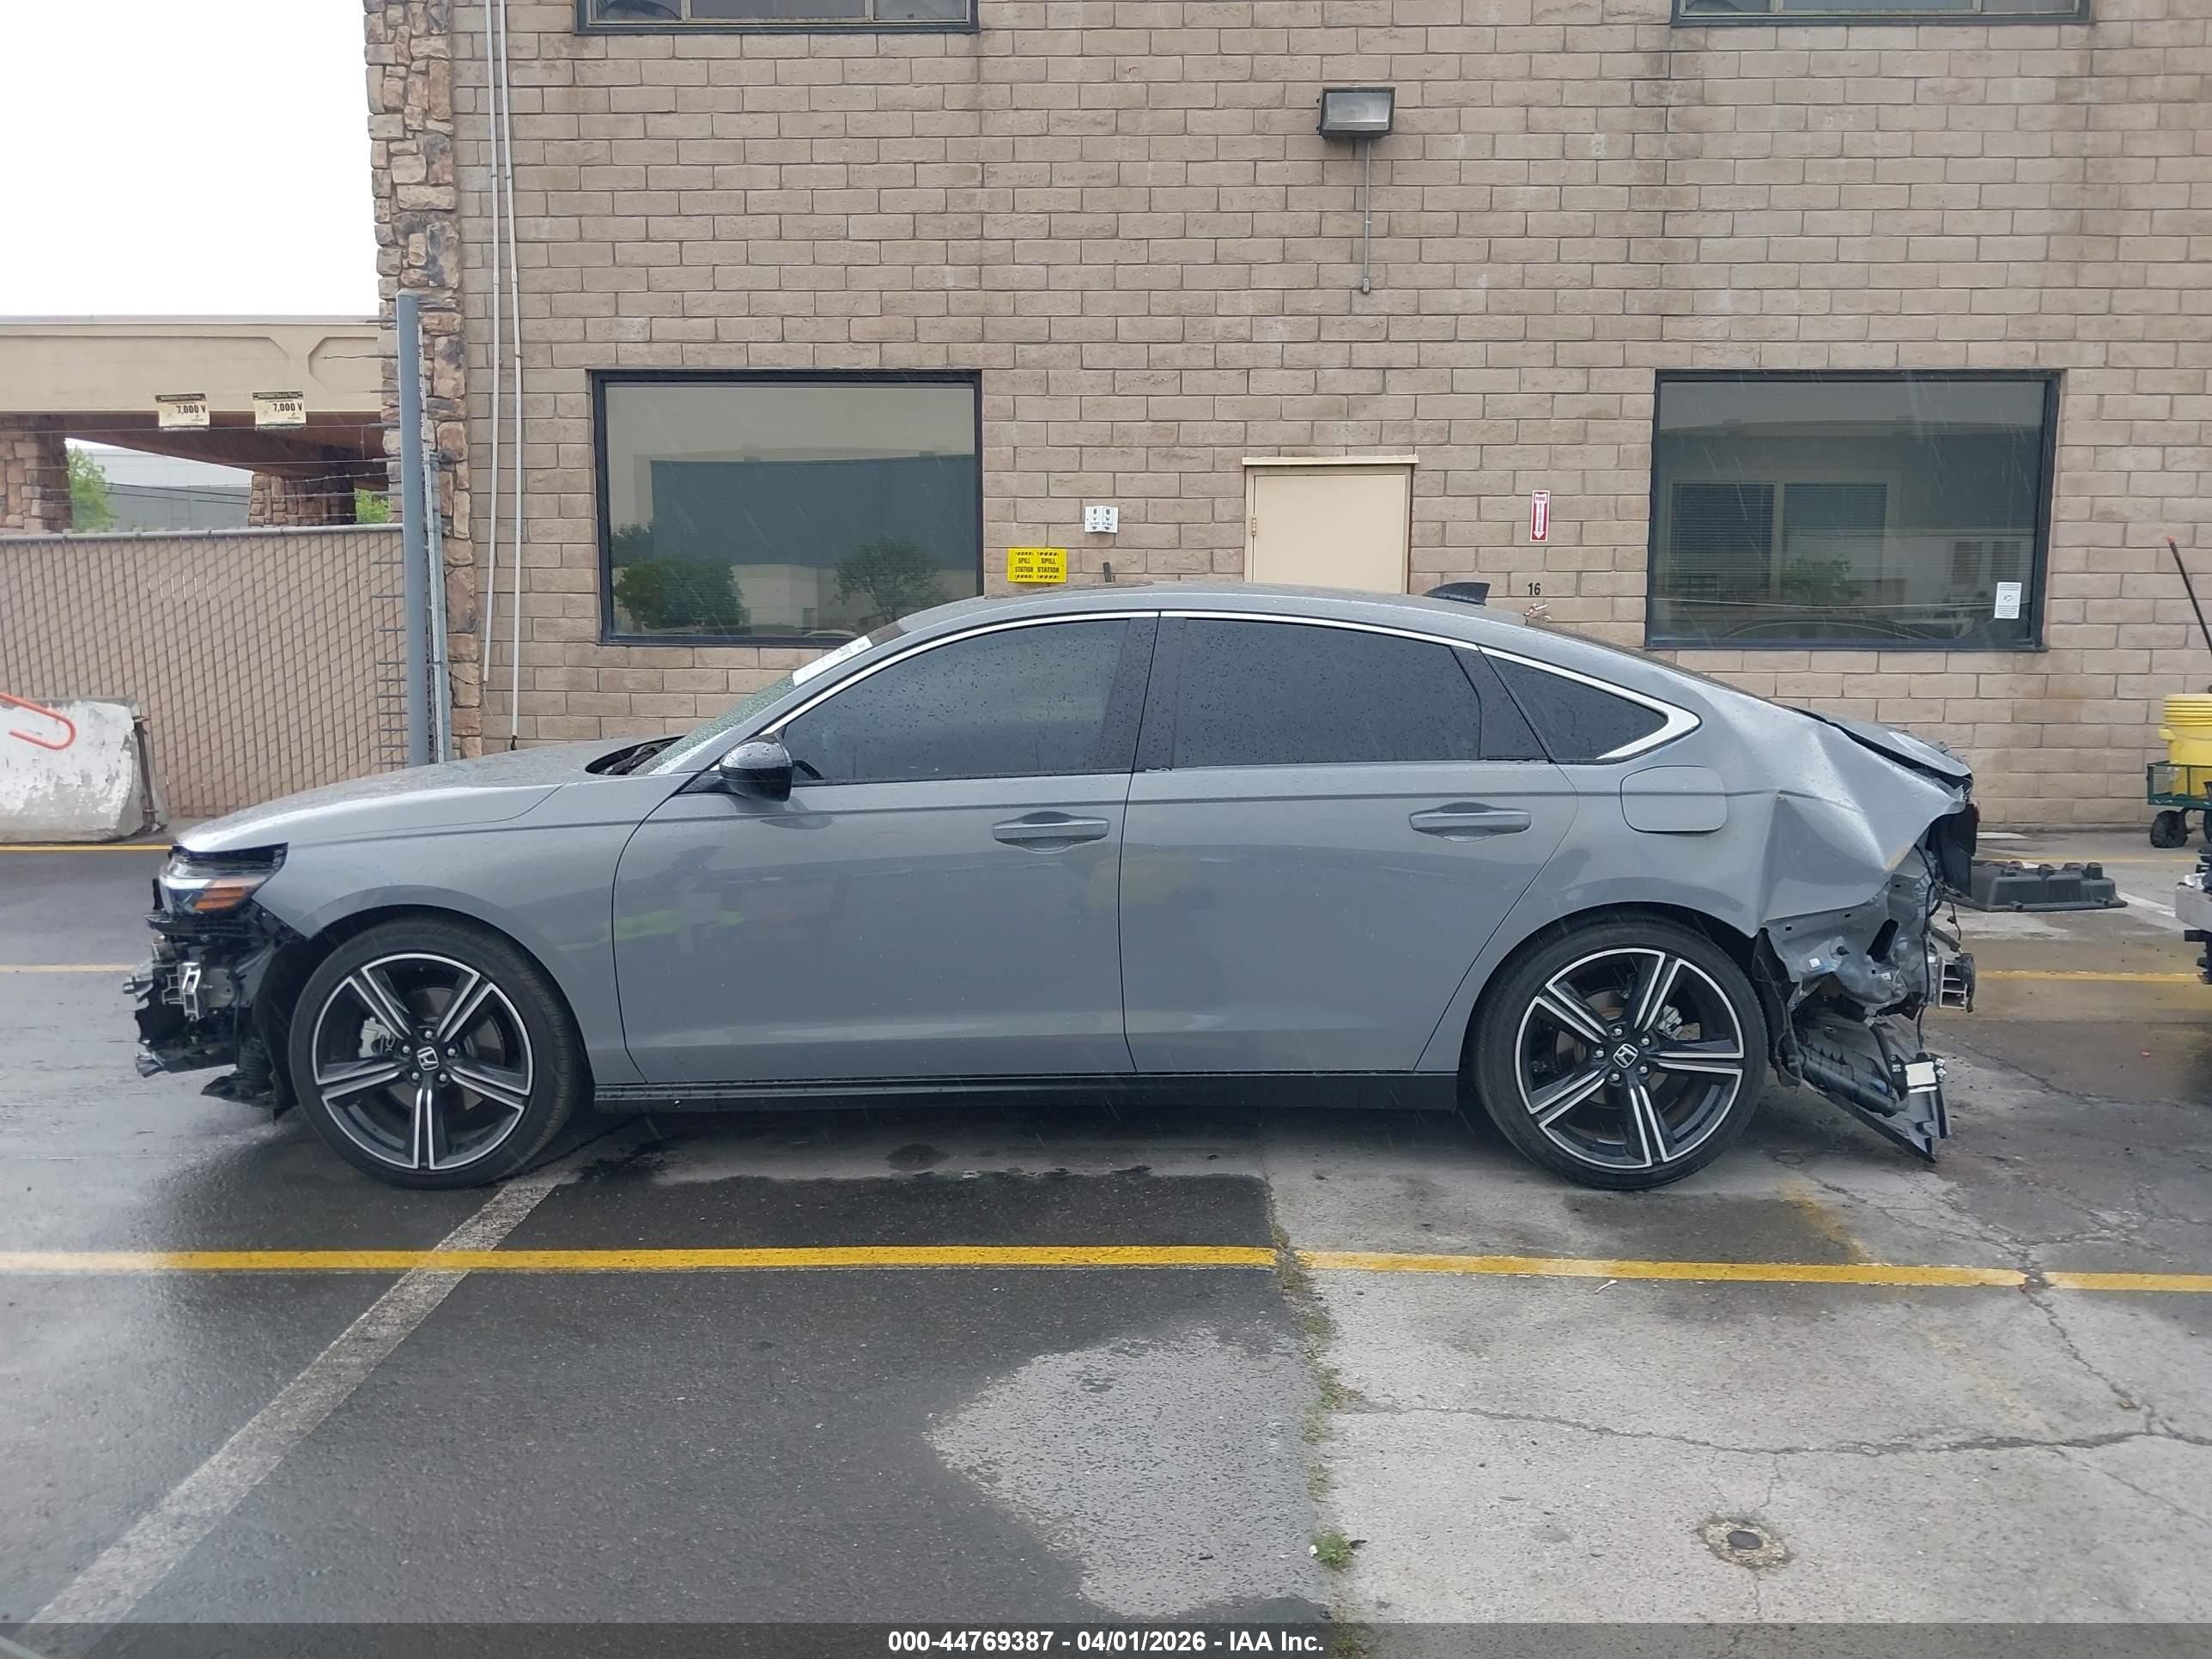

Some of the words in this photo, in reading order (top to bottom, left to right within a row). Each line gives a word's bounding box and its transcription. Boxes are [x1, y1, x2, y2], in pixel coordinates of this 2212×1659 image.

[176, 404, 199, 415] 7,000
[200, 404, 206, 413] V
[272, 403, 295, 412] 7,000
[297, 403, 302, 411] V
[1528, 582, 1540, 595] 16
